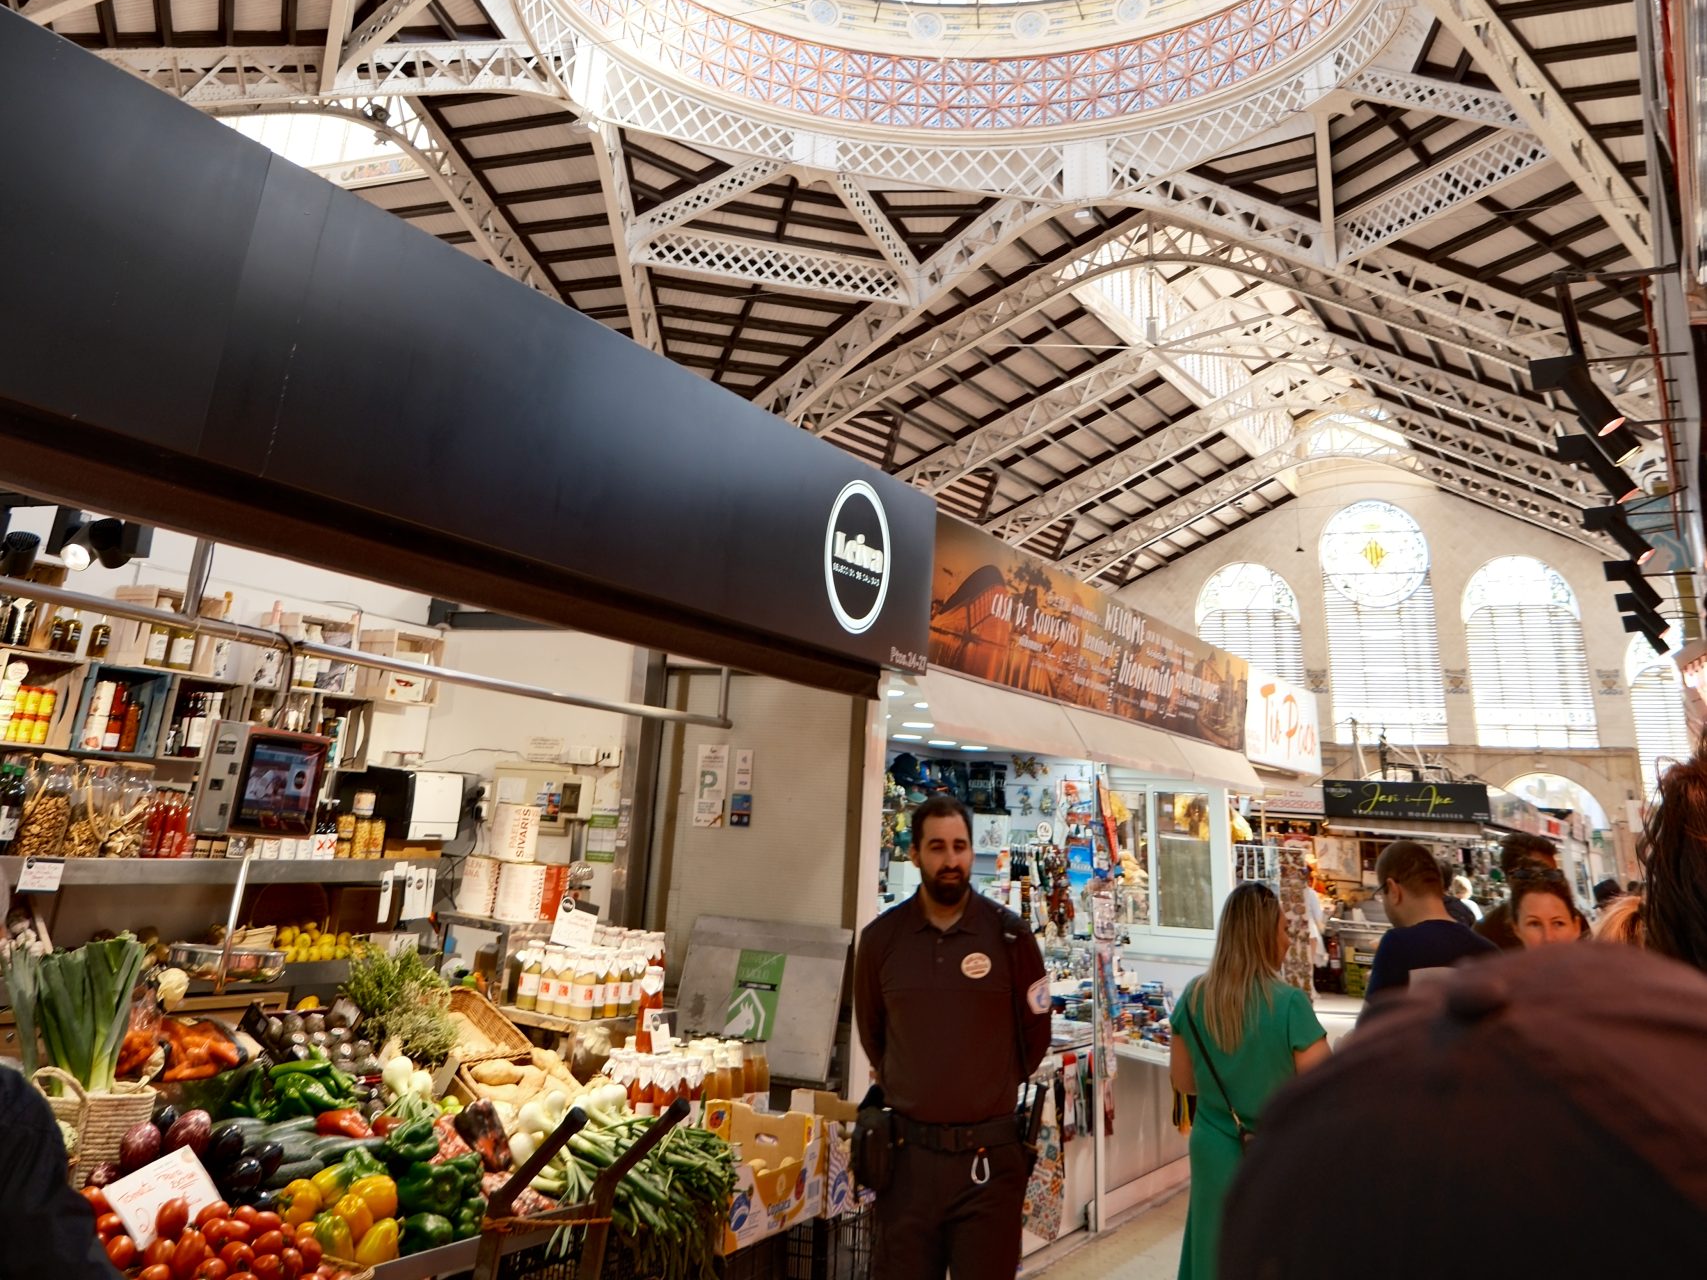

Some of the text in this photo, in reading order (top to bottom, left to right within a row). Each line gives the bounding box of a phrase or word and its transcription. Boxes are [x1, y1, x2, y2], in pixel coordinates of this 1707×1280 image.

[991, 593, 1013, 622] CASA
[1015, 602, 1030, 628] DE
[1031, 608, 1080, 647] SOUVENIRS
[1104, 603, 1146, 645] WELCOME
[1117, 650, 1175, 699] bienvenido
[516, 808, 531, 858] SIVARIS
